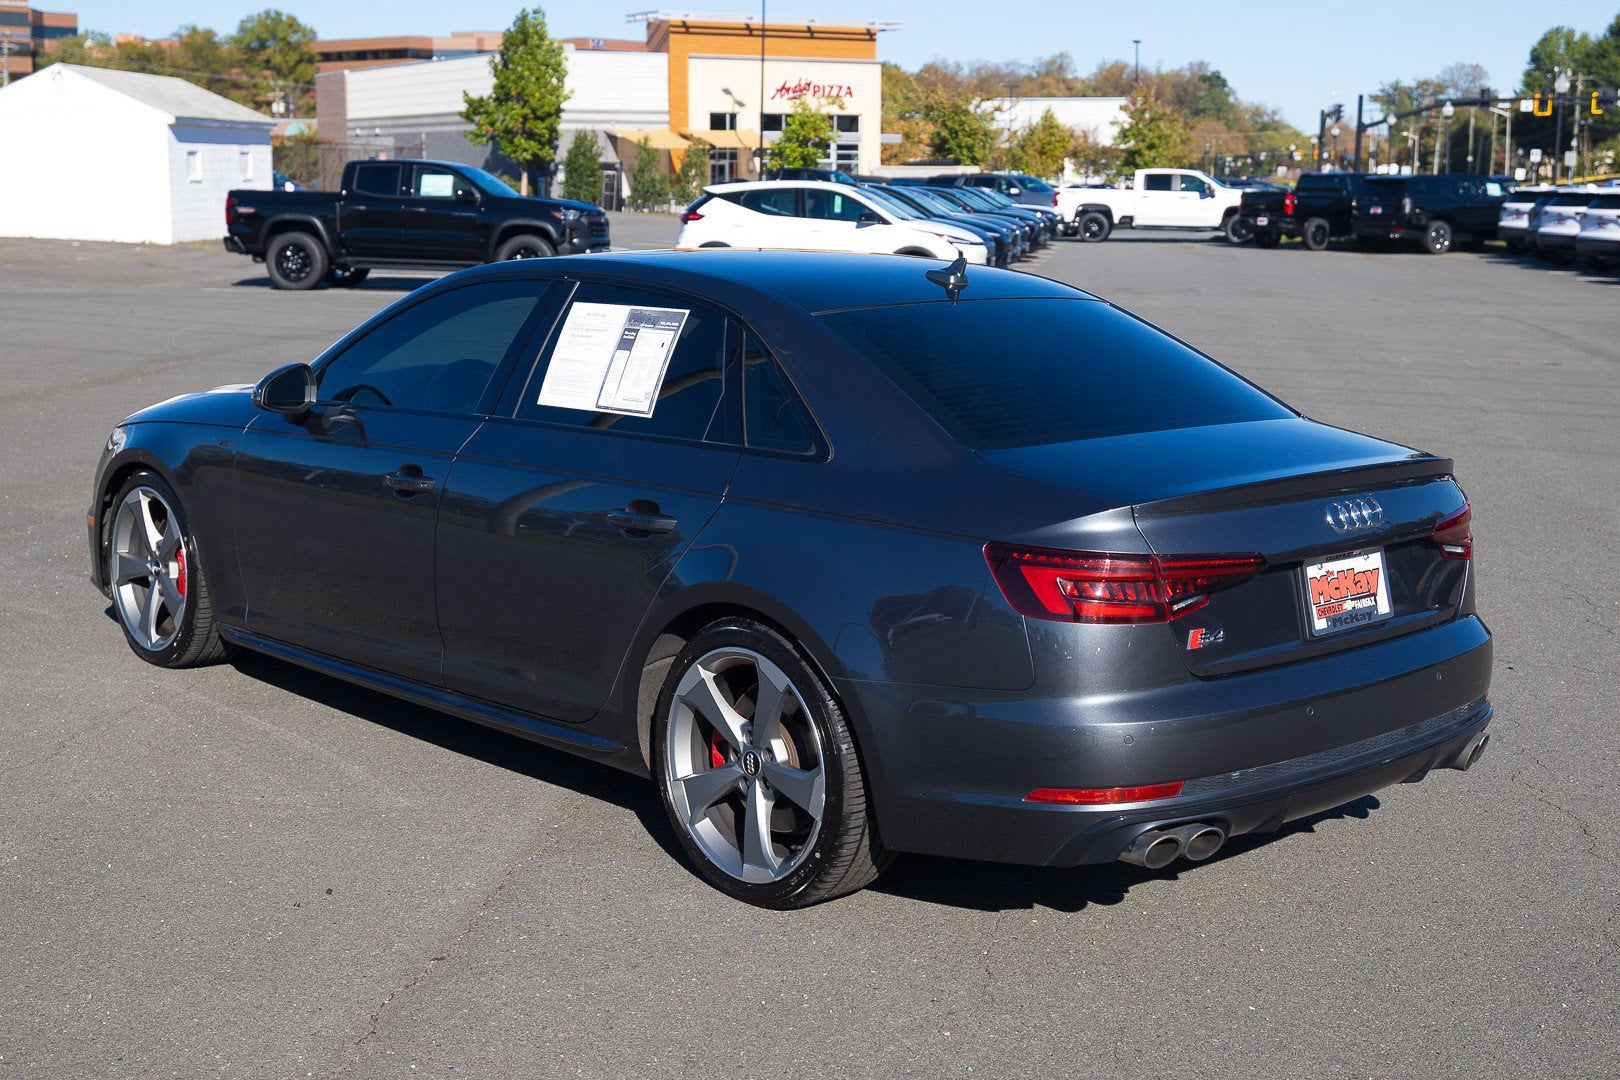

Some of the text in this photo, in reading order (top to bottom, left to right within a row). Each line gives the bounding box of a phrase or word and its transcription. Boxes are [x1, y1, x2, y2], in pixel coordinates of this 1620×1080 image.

[812, 84, 853, 98] PIZZA
[1309, 568, 1379, 605] McKay
[1317, 604, 1343, 617] CHEVROLET
[1332, 611, 1372, 627] McKay
